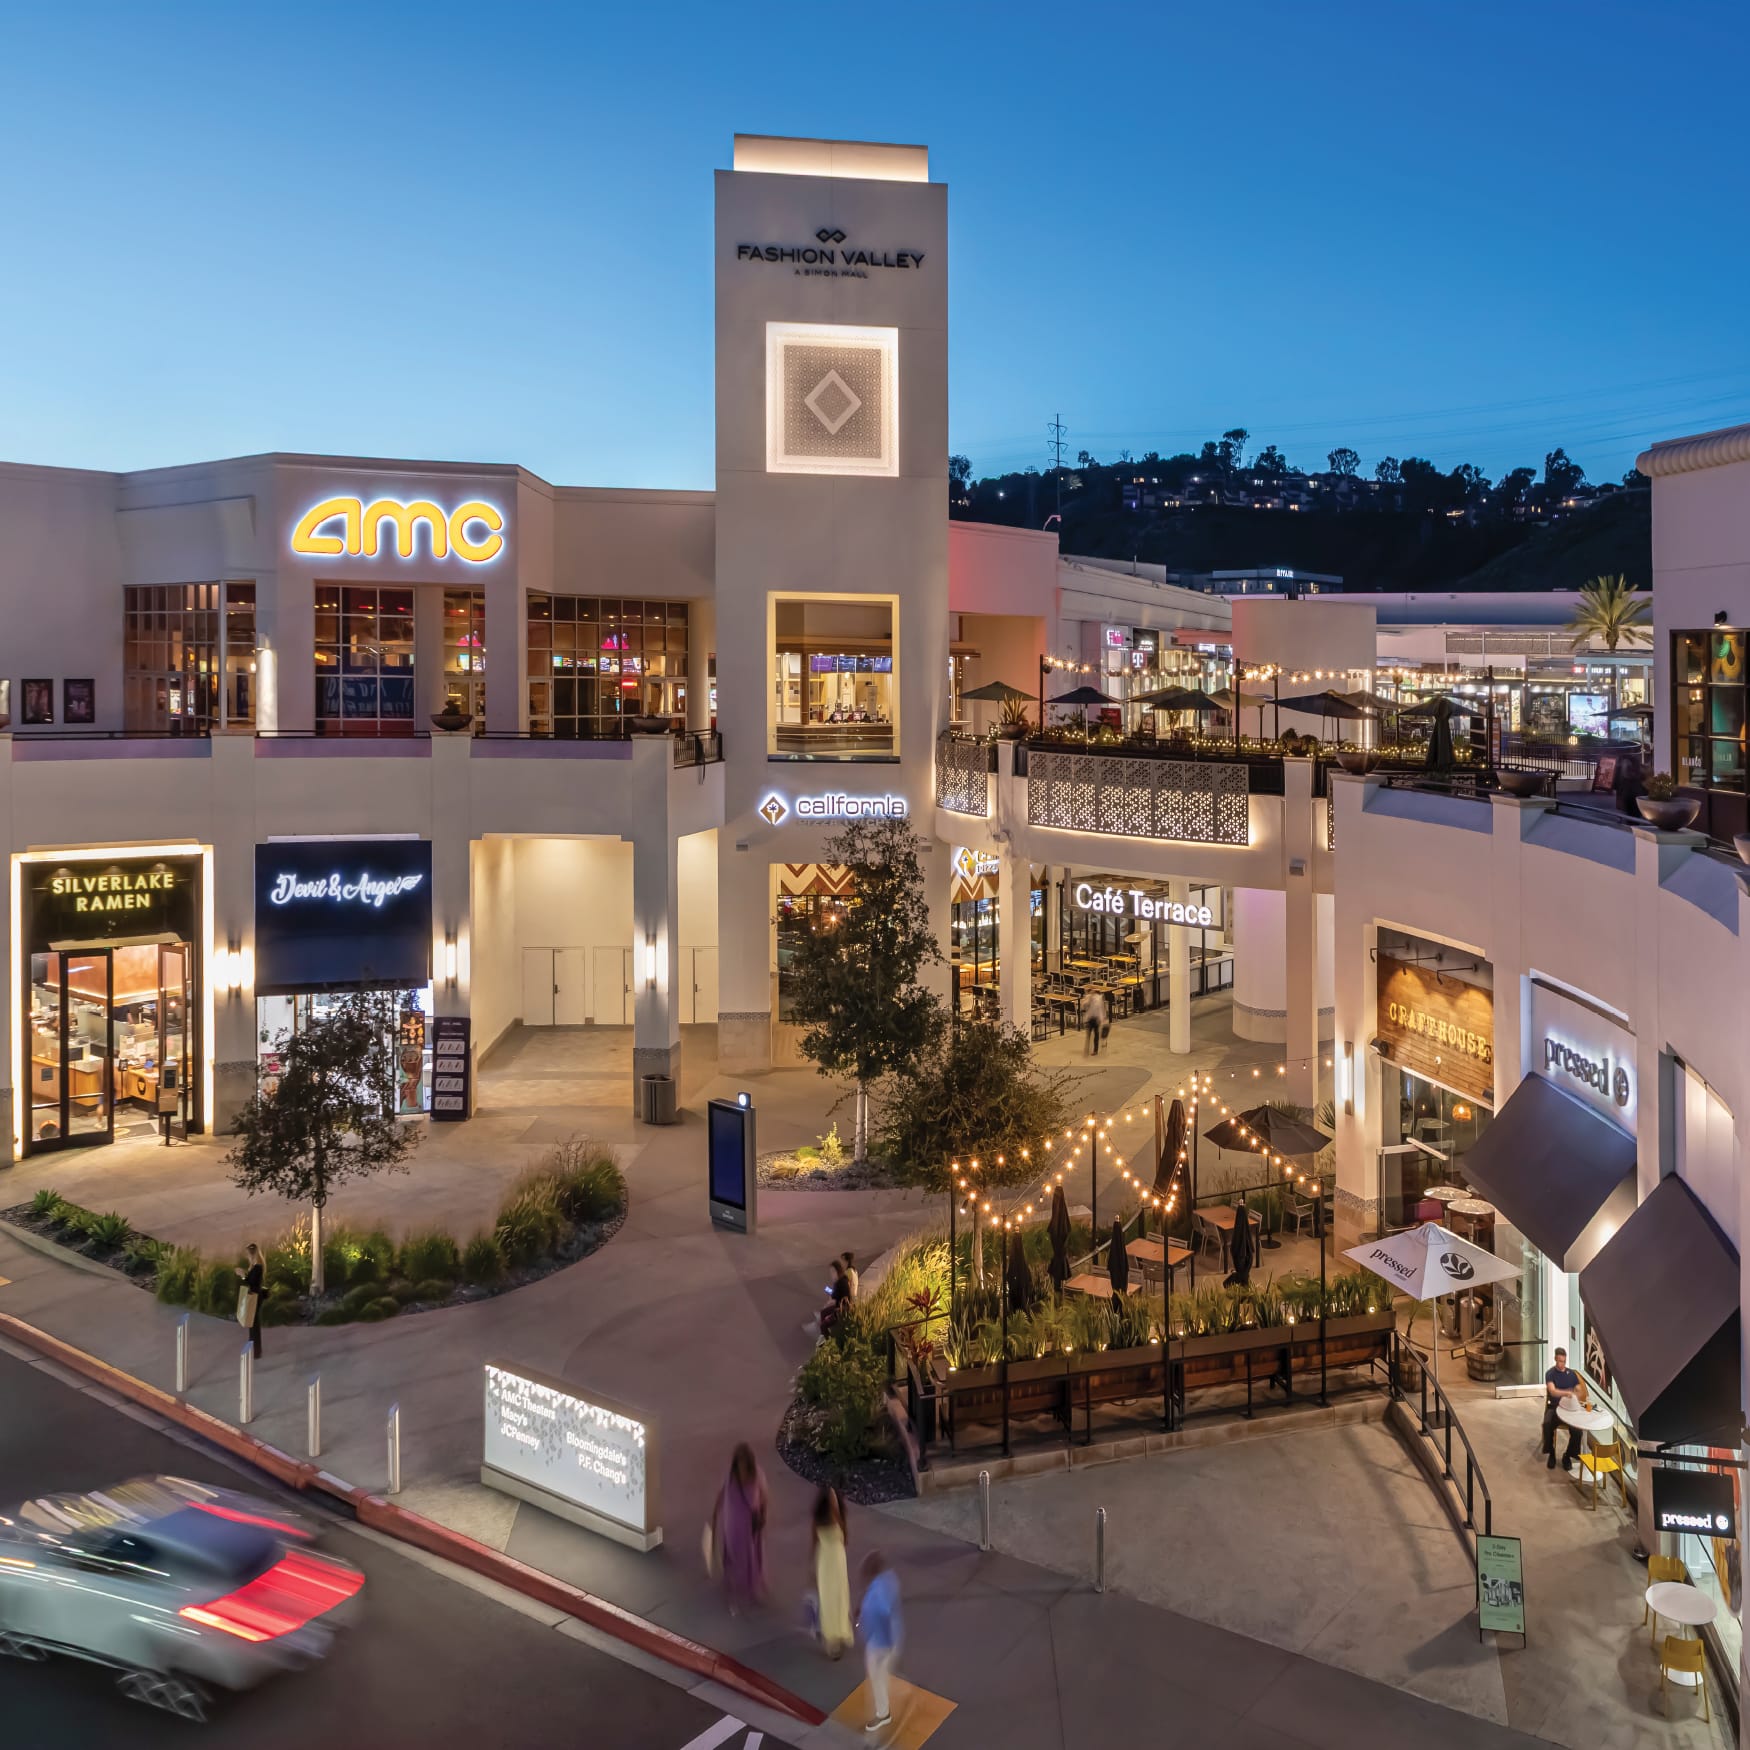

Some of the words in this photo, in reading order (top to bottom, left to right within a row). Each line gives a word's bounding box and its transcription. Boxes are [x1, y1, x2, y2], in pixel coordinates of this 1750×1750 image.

[737, 245, 834, 264] FASHION
[841, 251, 925, 268] VALLEY
[804, 269, 837, 277] SIMON
[841, 271, 868, 279] MALL
[52, 873, 174, 895] SILVERLAKE
[270, 873, 328, 904] Devil
[328, 873, 341, 902] &
[342, 871, 401, 907] Angel
[76, 893, 151, 912] RAMEN
[1076, 883, 1125, 914] Café
[1128, 890, 1212, 926] Terrace
[1544, 1038, 1609, 1096] pressed
[1370, 1249, 1417, 1278] pressed
[501, 1389, 521, 1407] AMC
[521, 1396, 556, 1420] Theaters
[501, 1406, 528, 1426] Macy's
[501, 1422, 540, 1451] JCPenney
[566, 1431, 627, 1467] Bloomingdale's
[578, 1453, 593, 1470] P.F.
[593, 1460, 627, 1484] Chang's
[1661, 1513, 1712, 1529] pressed
